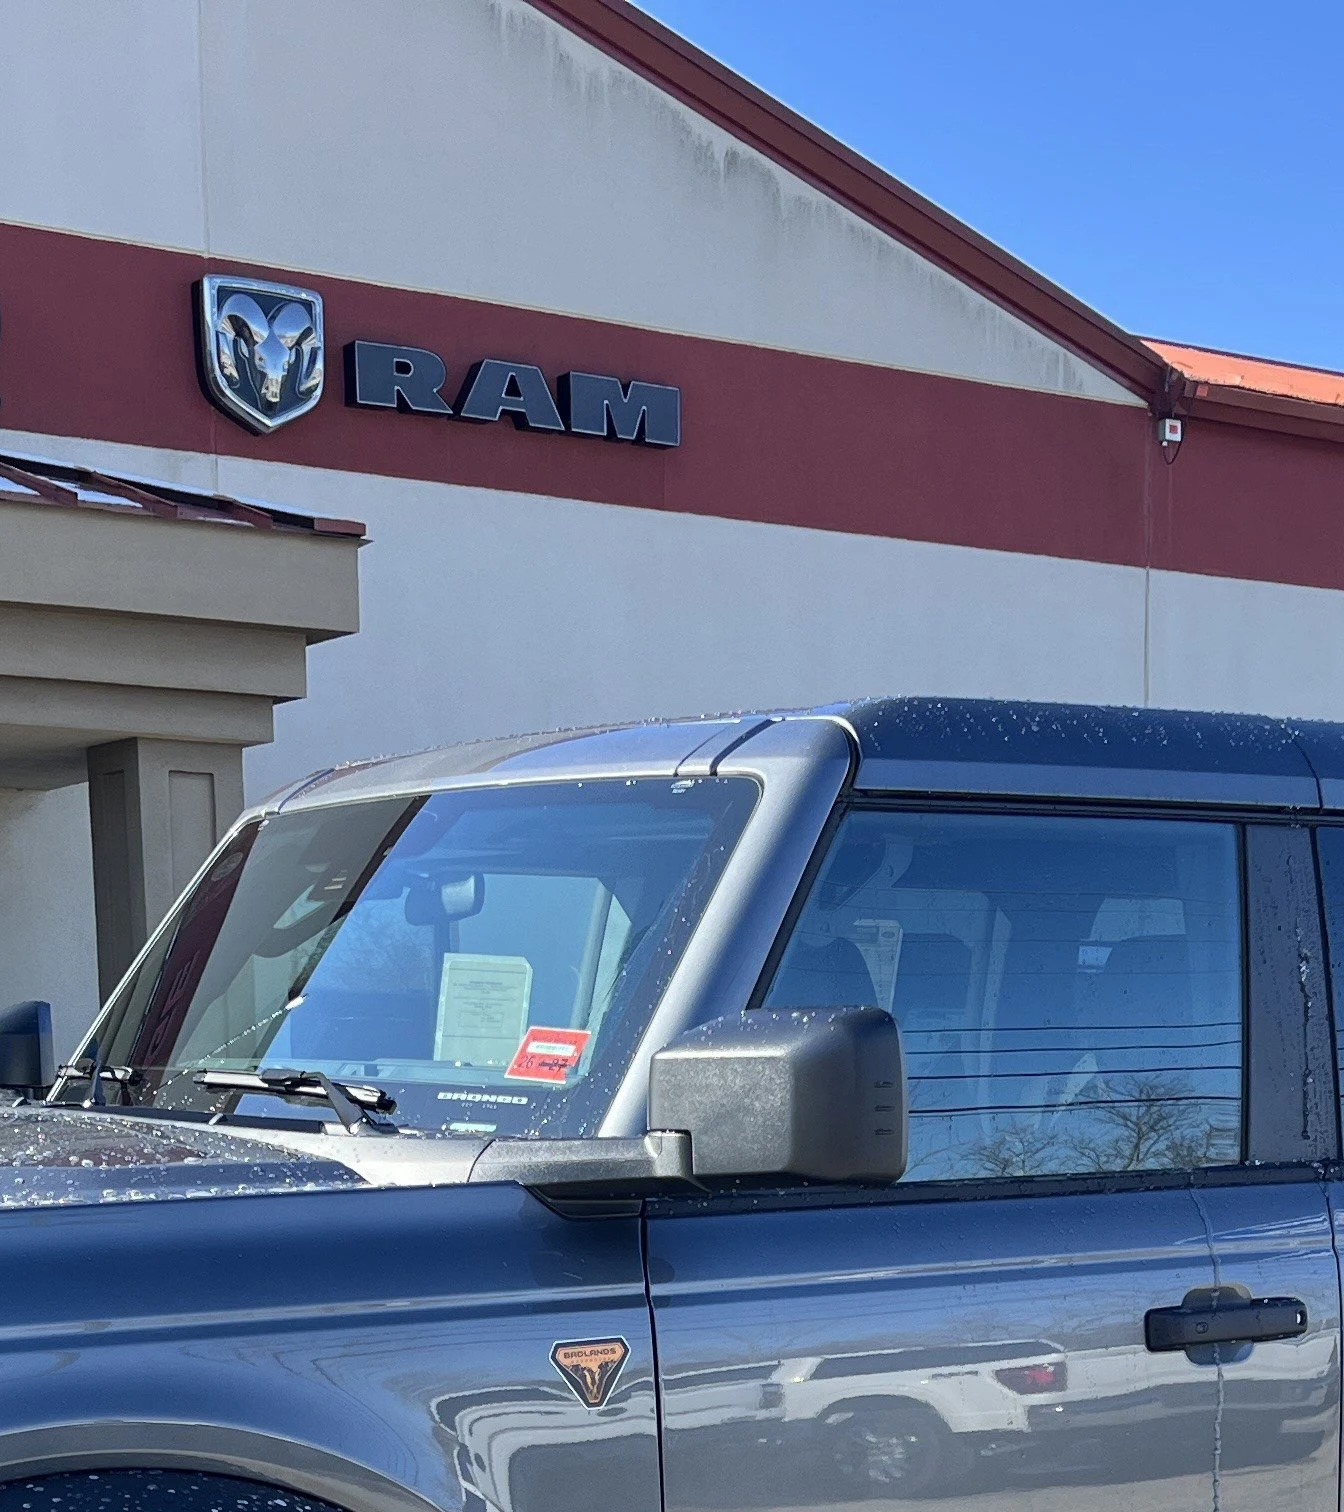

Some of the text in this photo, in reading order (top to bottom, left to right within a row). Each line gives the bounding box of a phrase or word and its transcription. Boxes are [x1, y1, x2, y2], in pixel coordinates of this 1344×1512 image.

[348, 340, 682, 448] RAM
[436, 1091, 529, 1105] BRONCO
[563, 1347, 617, 1359] BADLANDS
